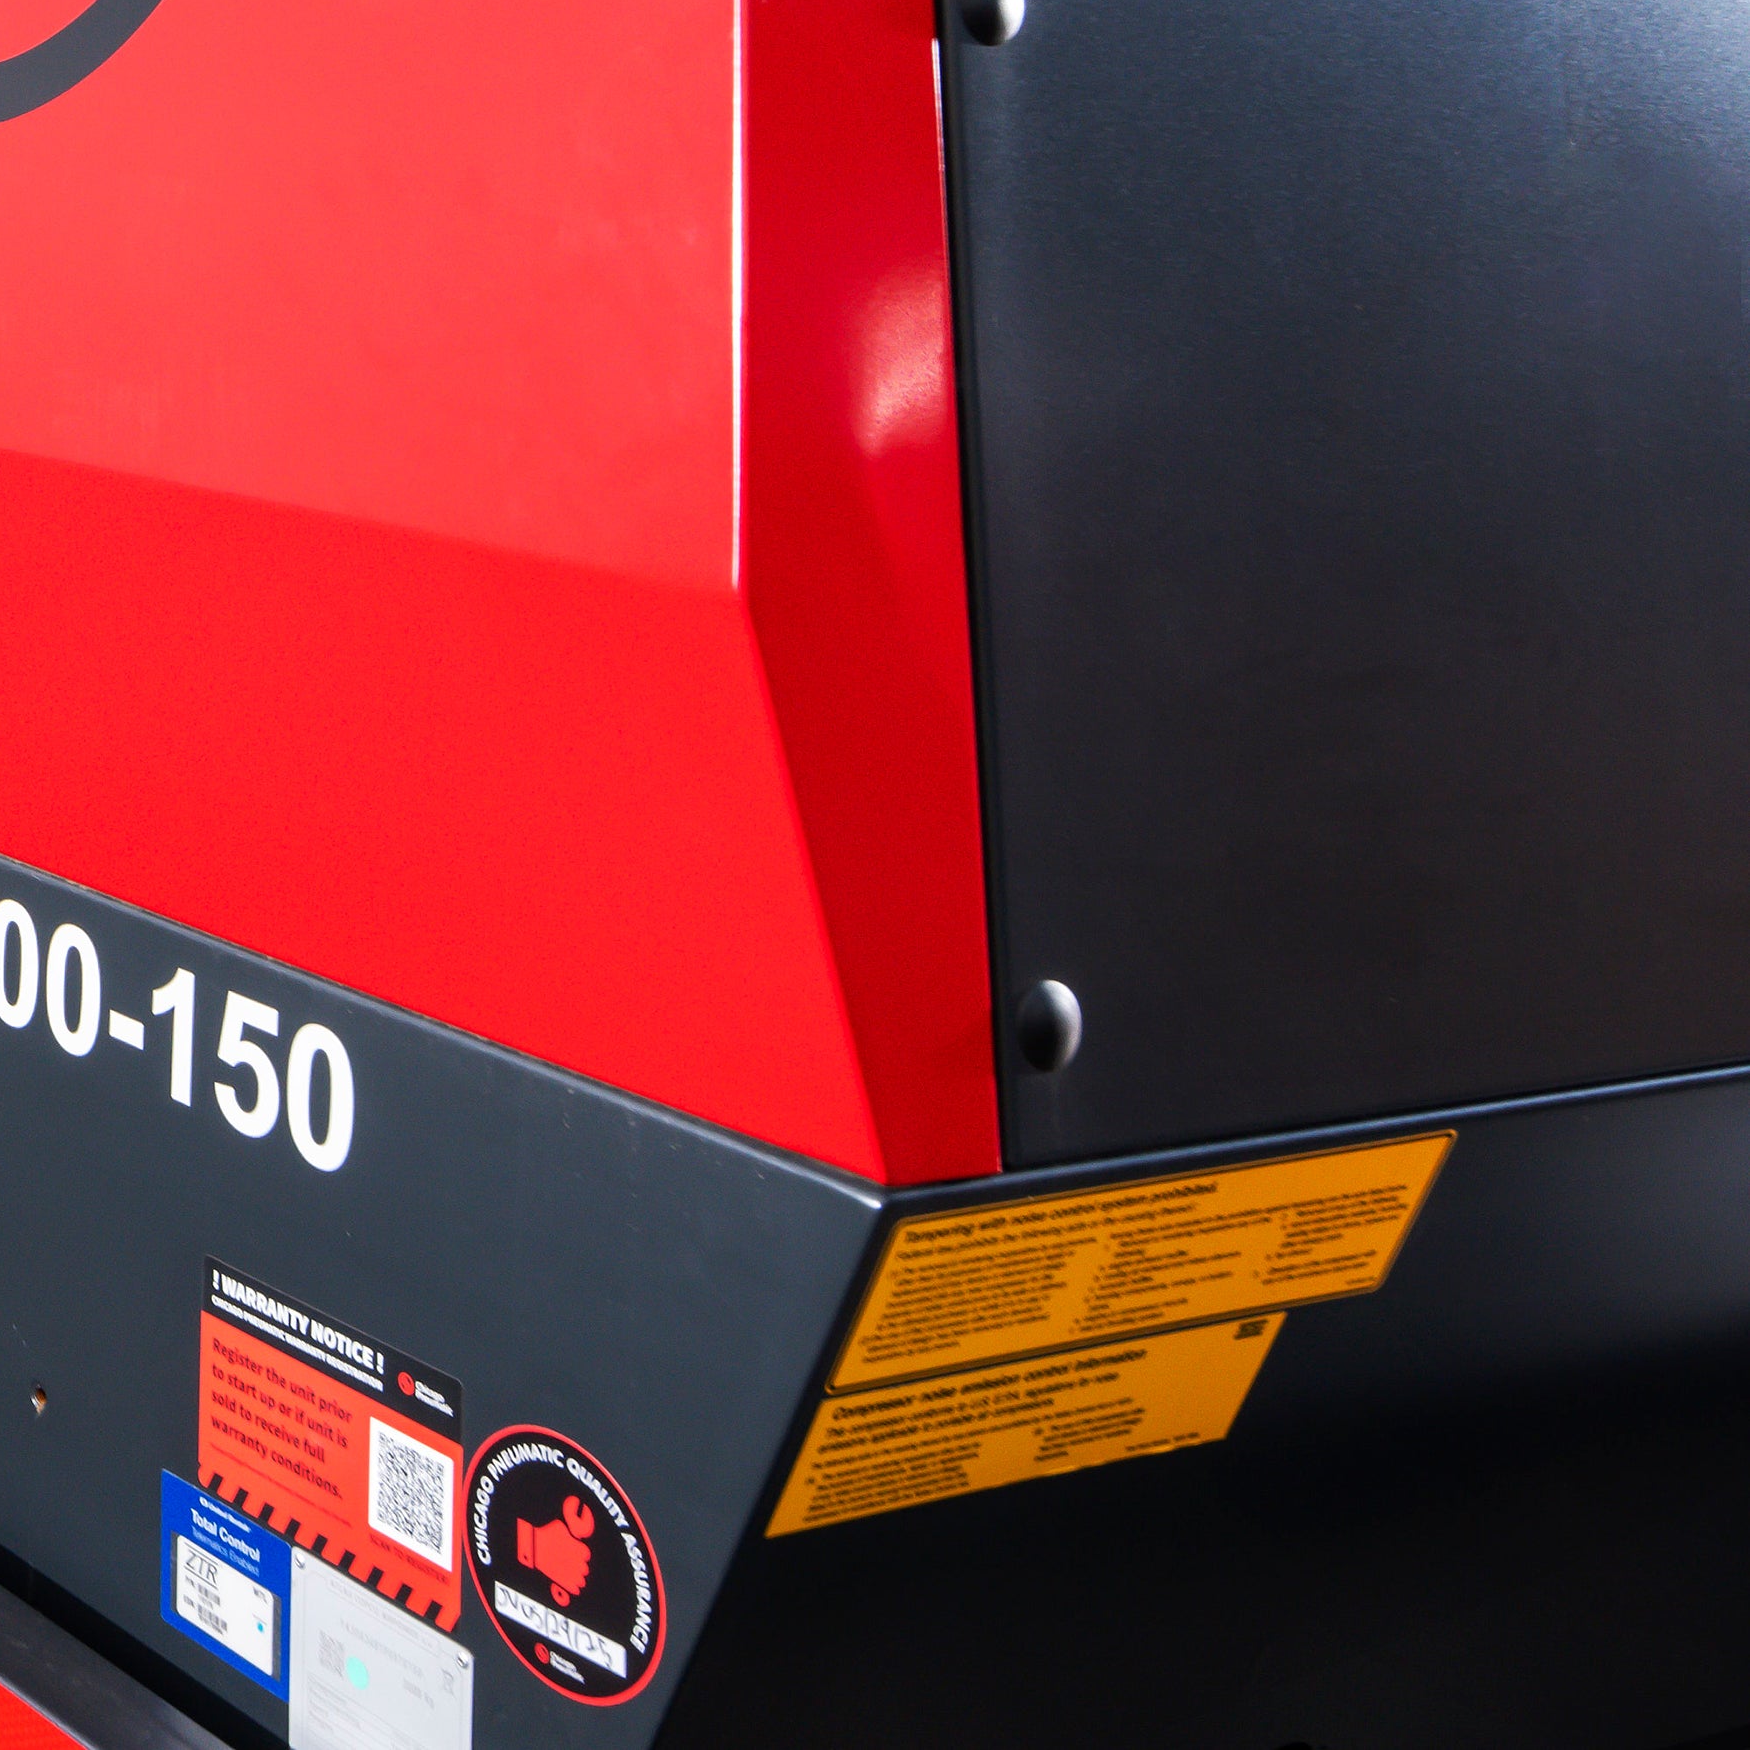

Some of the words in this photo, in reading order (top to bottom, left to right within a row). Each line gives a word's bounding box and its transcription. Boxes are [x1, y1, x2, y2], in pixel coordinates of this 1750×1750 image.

[221, 1273, 308, 1336] WARRANTY
[311, 1319, 373, 1370] NOTICE
[212, 1363, 223, 1381] to
[228, 1371, 256, 1399] start
[260, 1391, 273, 1411] up
[278, 1401, 290, 1418] or
[295, 1407, 304, 1425] if
[307, 1414, 332, 1440] unit
[337, 1430, 347, 1448] is
[213, 1337, 261, 1379] Register
[266, 1363, 285, 1389] the
[290, 1377, 315, 1405] unit
[319, 1392, 351, 1426] prior
[211, 1415, 266, 1460] warranty
[271, 1446, 341, 1500] conditions.
[212, 1387, 235, 1413] sold
[240, 1404, 250, 1421] to
[255, 1412, 299, 1449] receive
[303, 1437, 324, 1463] full
[186, 1548, 217, 1585] ZTR
[191, 1508, 216, 1536] Total
[219, 1525, 259, 1563] Control
[474, 1476, 495, 1566] CHICAGO
[489, 1443, 565, 1482] PNEUMATIC
[566, 1457, 630, 1528] QUALITY
[621, 1532, 653, 1654] ASSURANCE
